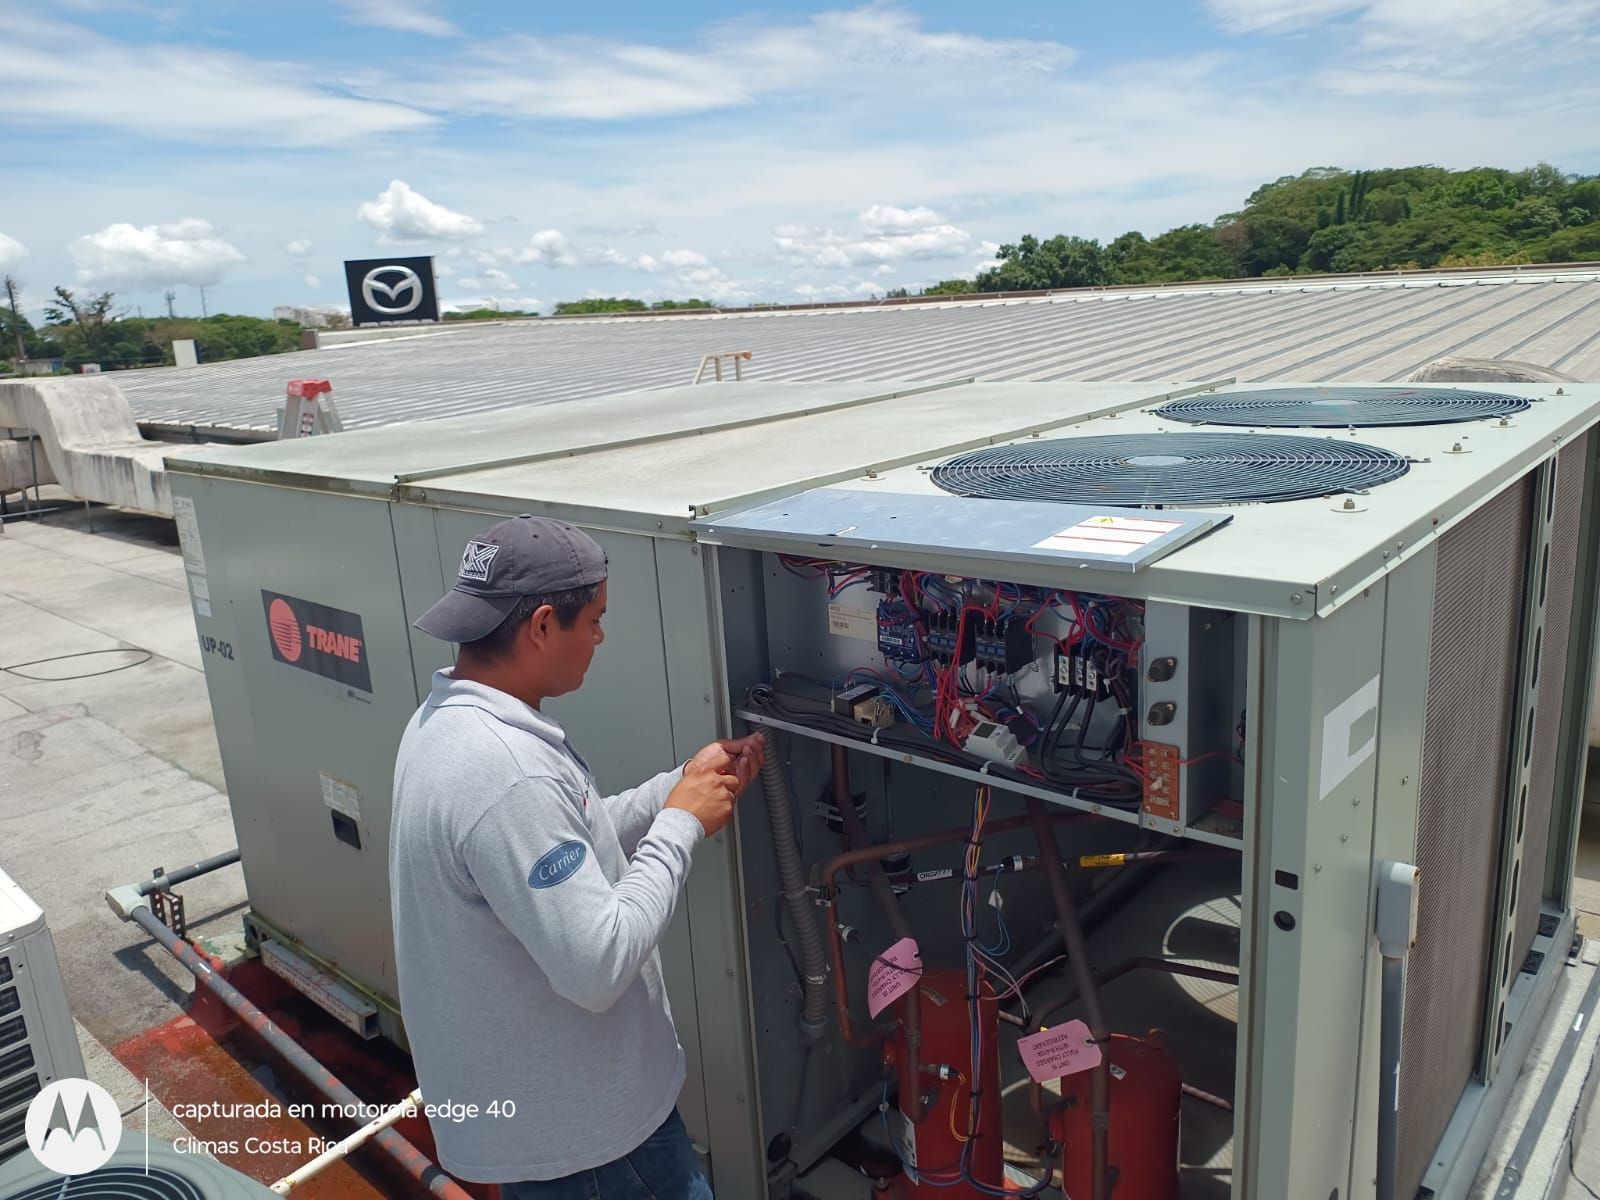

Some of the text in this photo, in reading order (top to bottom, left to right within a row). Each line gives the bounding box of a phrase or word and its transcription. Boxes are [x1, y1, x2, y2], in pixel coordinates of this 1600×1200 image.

[202, 635, 234, 661] UP-02
[306, 624, 361, 663] TRANE
[538, 847, 580, 881] Carrier
